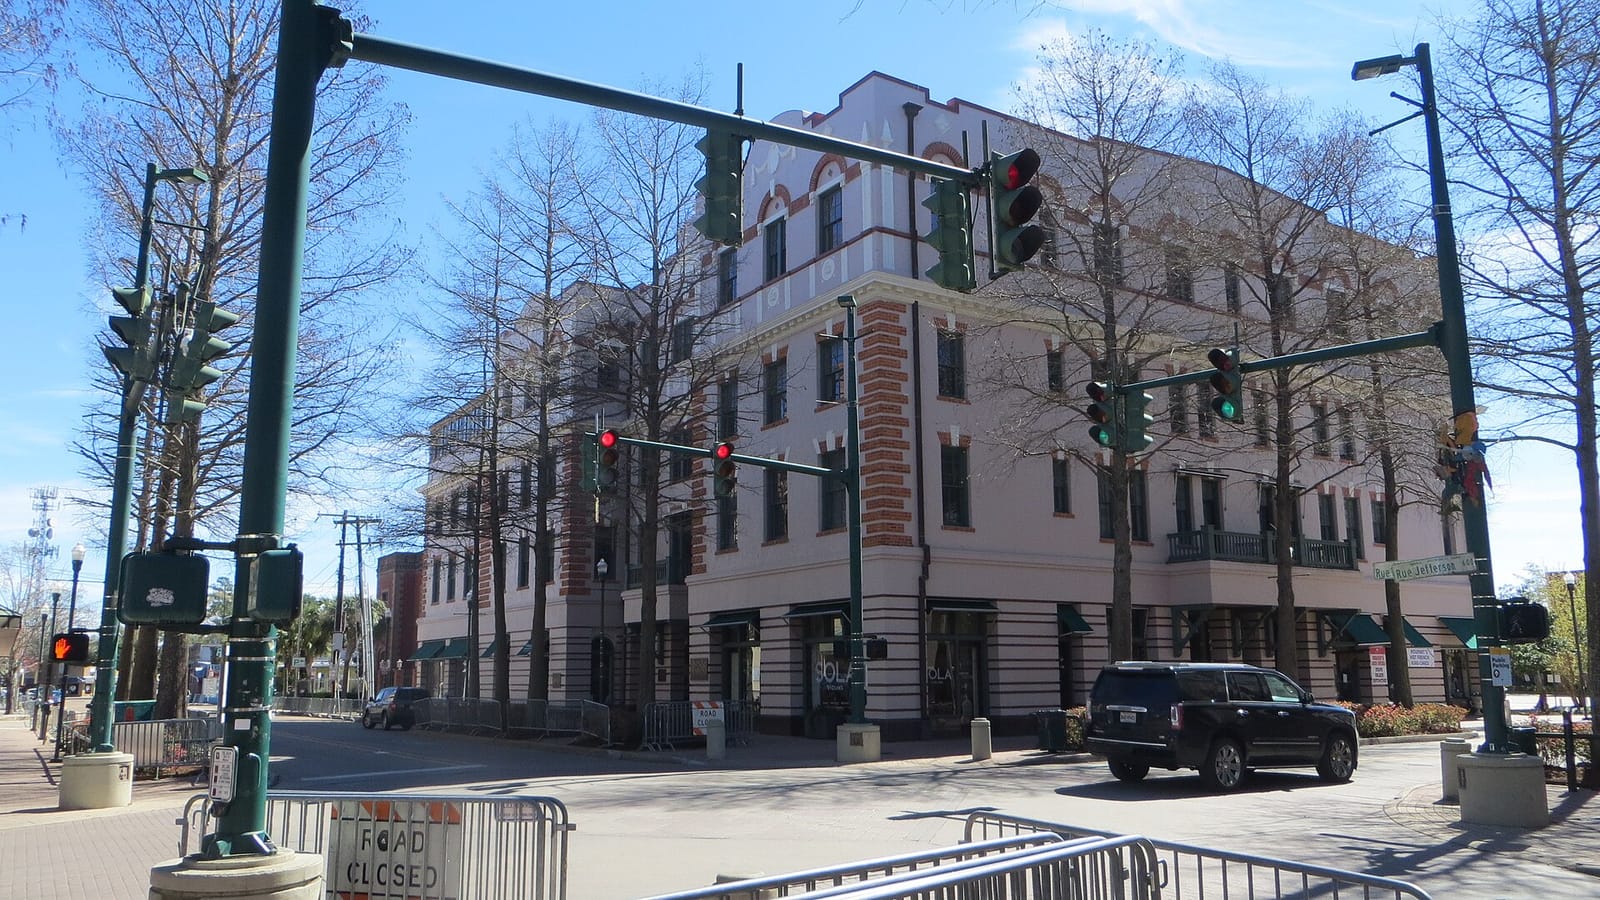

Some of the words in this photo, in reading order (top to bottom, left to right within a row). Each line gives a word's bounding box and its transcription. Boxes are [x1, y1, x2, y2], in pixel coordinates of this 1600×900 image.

[1375, 568, 1391, 578] Rue
[1396, 568, 1413, 579] Rue
[1415, 562, 1456, 576] Jefferson
[361, 828, 425, 853] ROAD
[347, 862, 438, 888] CLOSED
